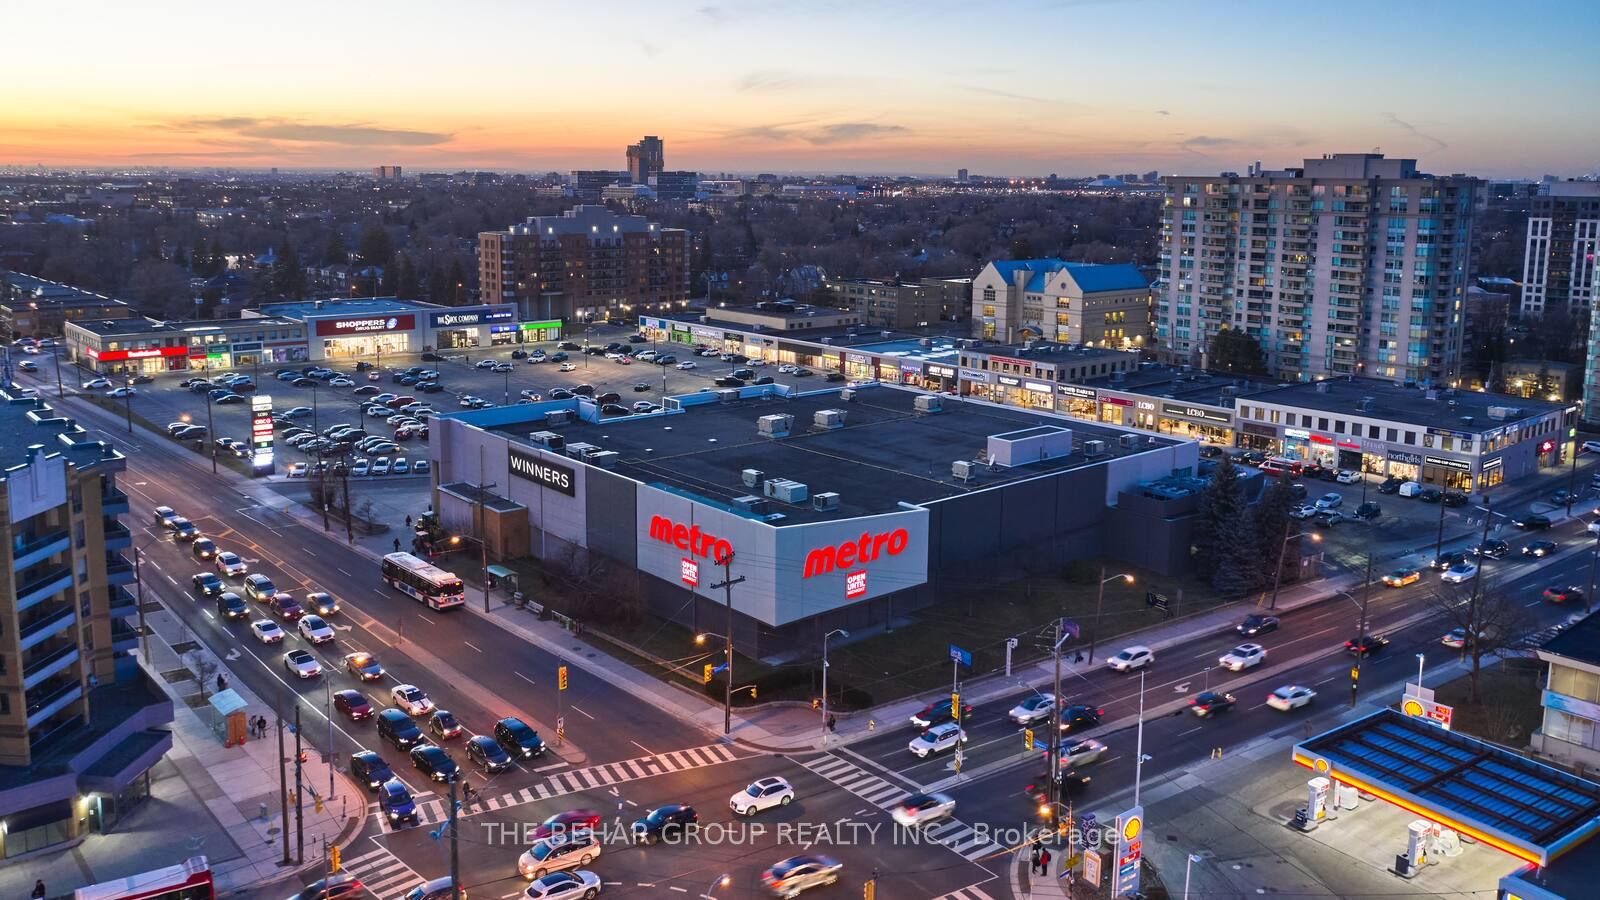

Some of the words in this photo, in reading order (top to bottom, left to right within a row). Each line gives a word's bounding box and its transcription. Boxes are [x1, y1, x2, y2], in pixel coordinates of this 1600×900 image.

[336, 319, 385, 329] SHOPPERS
[458, 314, 479, 323] COMPANY
[1138, 401, 1155, 411] LCBO
[1186, 407, 1205, 418] LCBO
[1387, 452, 1421, 464] northgirls
[510, 455, 569, 488] WINNERS
[649, 514, 733, 566] metro
[803, 528, 909, 579] metro
[682, 560, 697, 572] OPEN
[682, 568, 697, 579] UNTIL
[847, 572, 866, 583] OPEN
[847, 580, 866, 591] UNTIL
